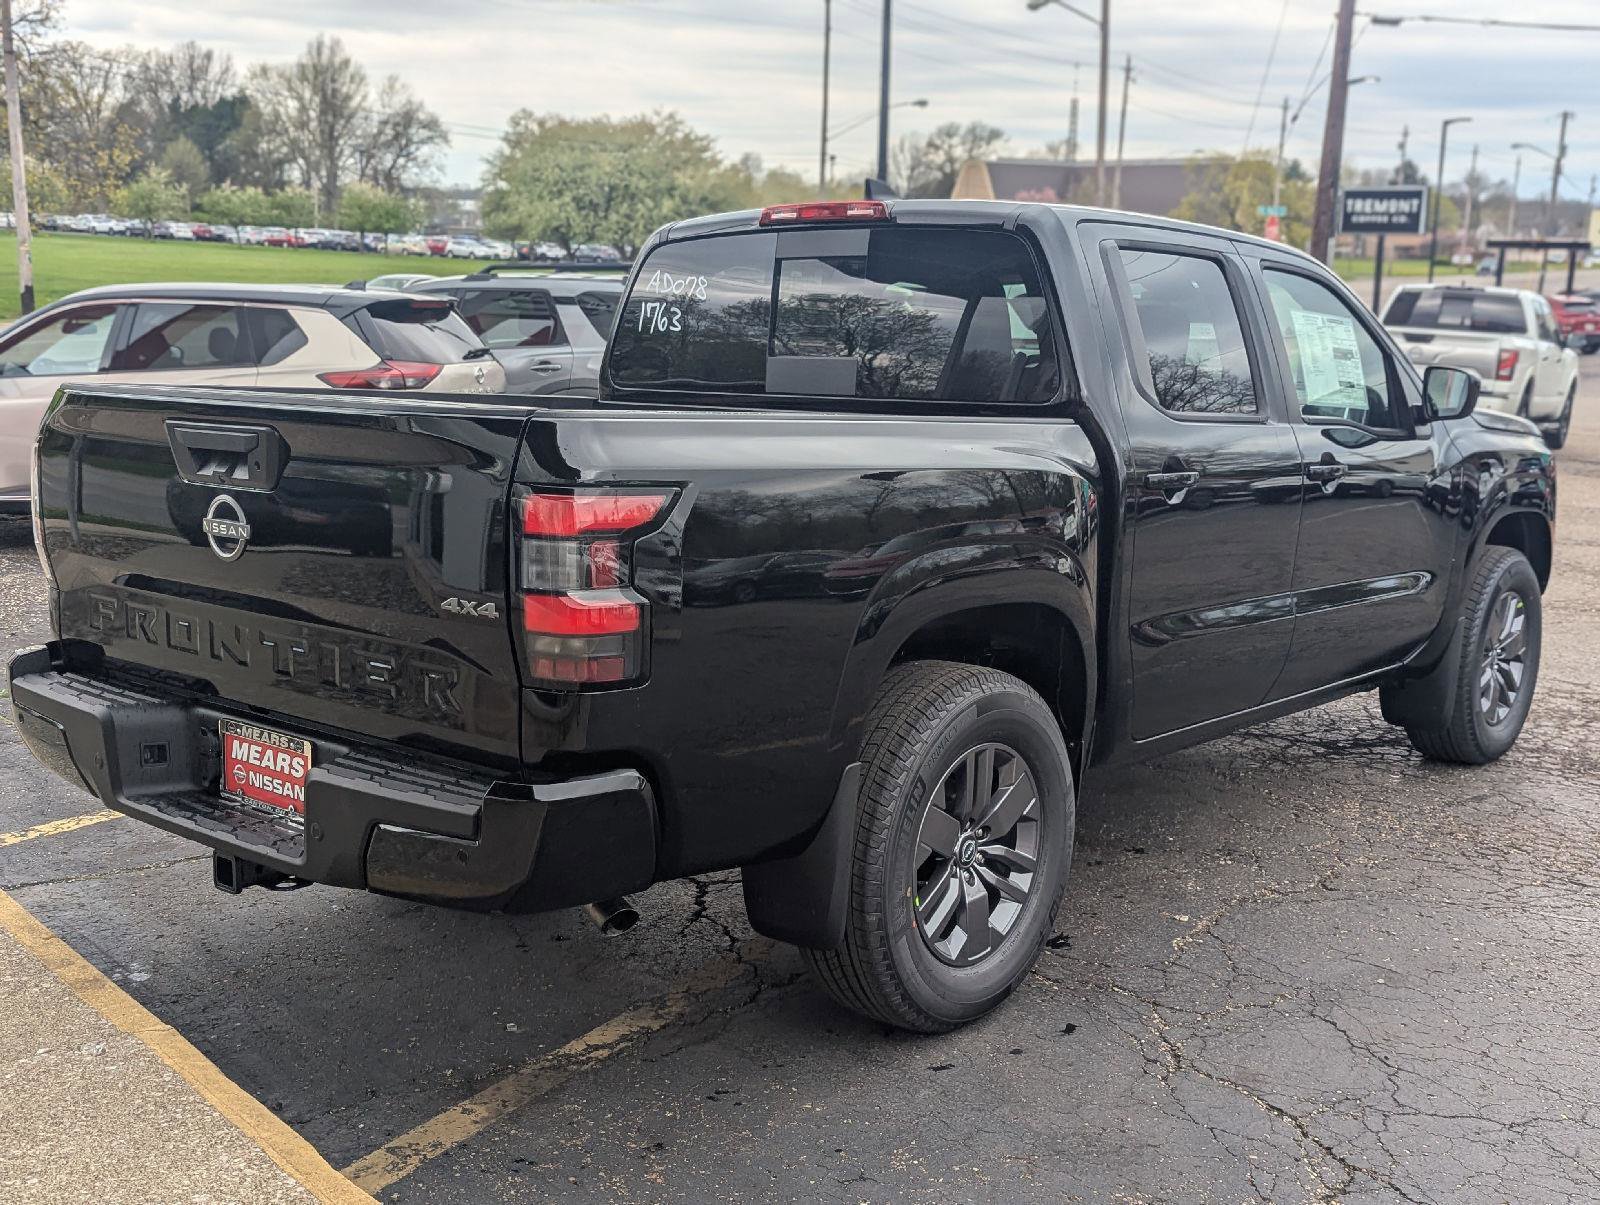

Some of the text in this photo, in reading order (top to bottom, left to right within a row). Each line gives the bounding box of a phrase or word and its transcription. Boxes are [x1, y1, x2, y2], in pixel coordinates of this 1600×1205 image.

[1346, 198, 1420, 214] TREMONT
[638, 301, 682, 334] 1763
[203, 520, 248, 538] NISSAN
[87, 590, 464, 714] FRONTIER
[241, 725, 290, 748] MEARS
[231, 739, 305, 778] MEARS
[248, 770, 305, 802] NISSAN
